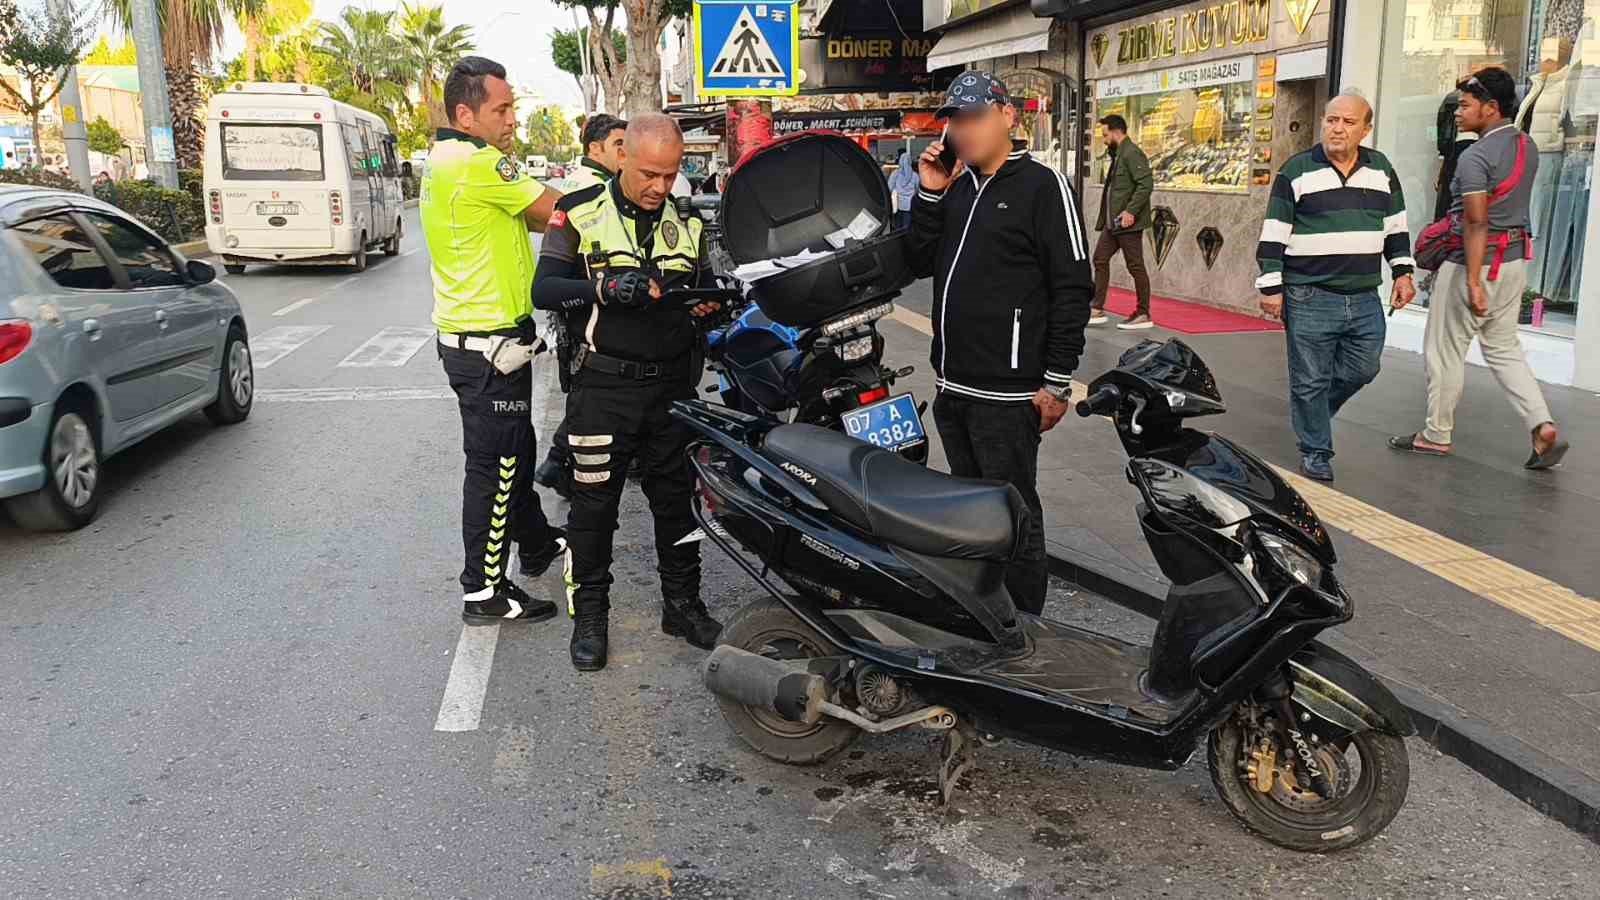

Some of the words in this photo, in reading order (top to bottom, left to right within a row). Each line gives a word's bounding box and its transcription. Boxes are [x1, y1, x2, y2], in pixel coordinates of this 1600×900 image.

[1180, 0, 1271, 55] KUYUM
[827, 35, 893, 58] DÖNER
[901, 38, 937, 57] MA
[1178, 68, 1199, 84] SATIŞ
[1199, 61, 1241, 81] MAĞAZASI
[845, 116, 885, 128] SCHÖNER
[848, 412, 870, 434] 07
[889, 404, 902, 421] A
[868, 420, 917, 447] 8382
[1287, 728, 1321, 777] ARORA
